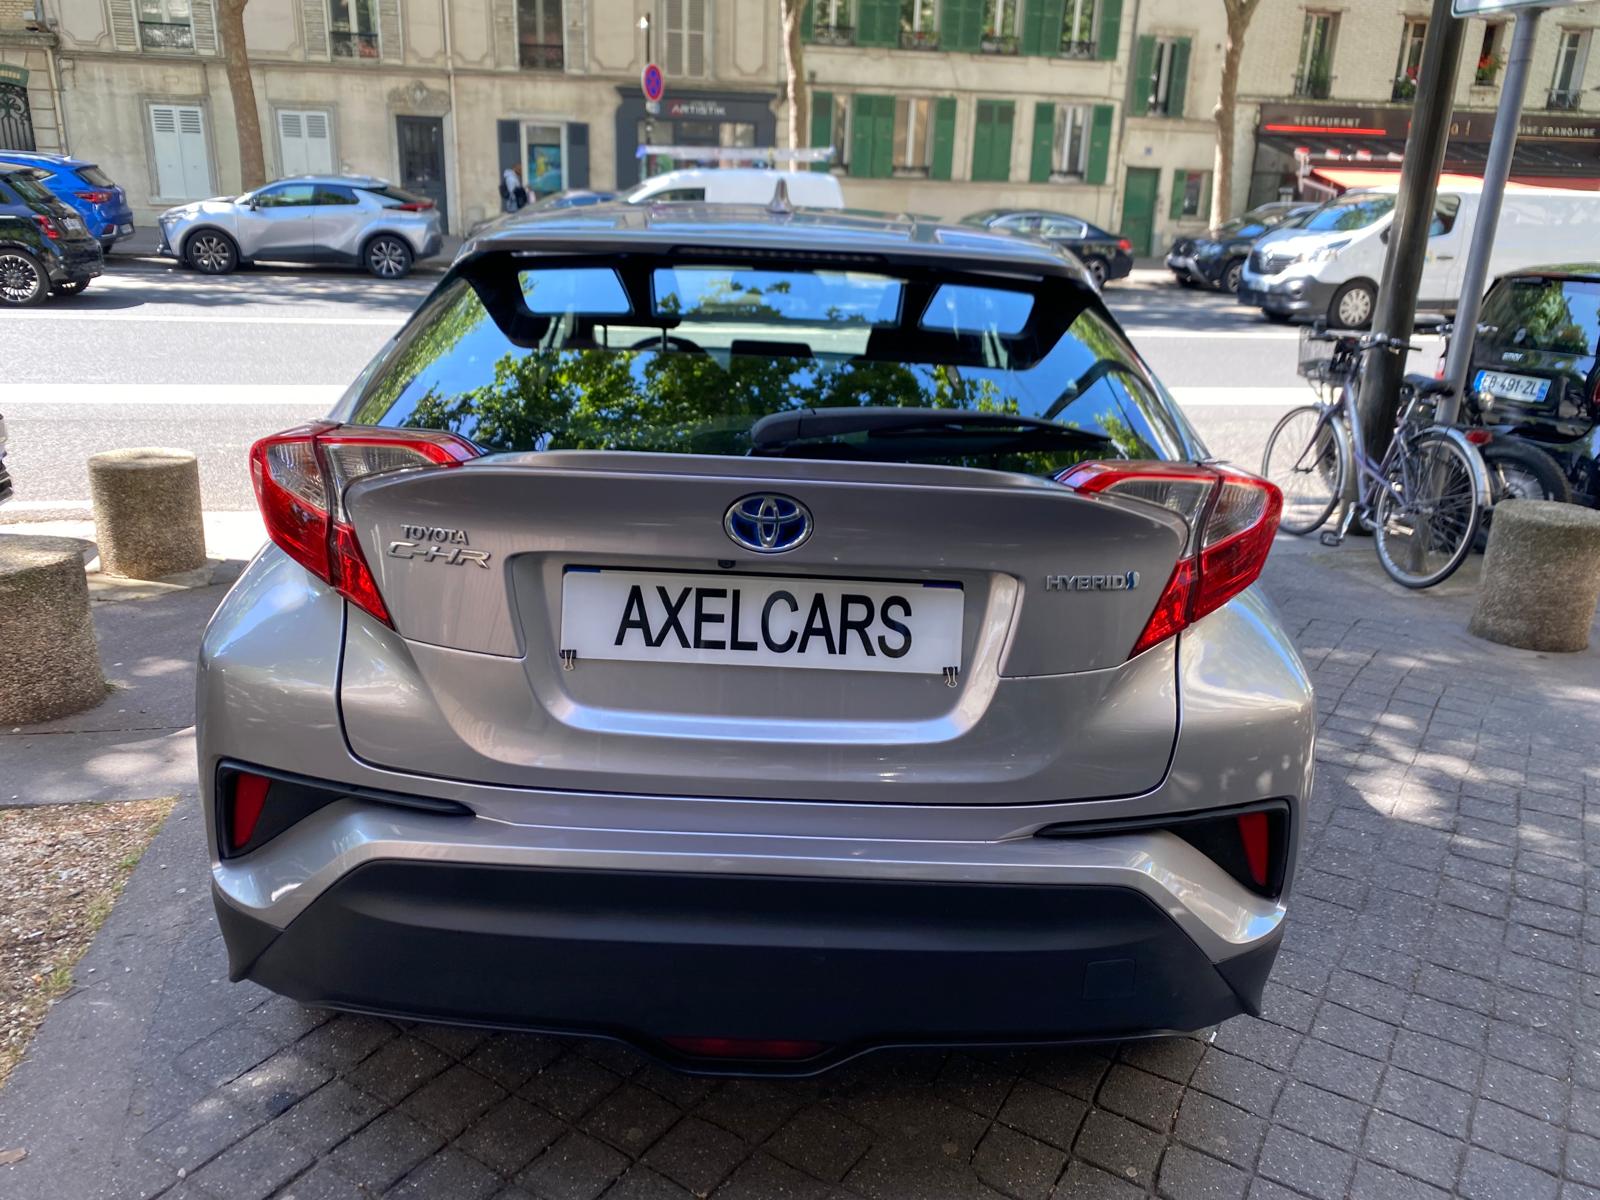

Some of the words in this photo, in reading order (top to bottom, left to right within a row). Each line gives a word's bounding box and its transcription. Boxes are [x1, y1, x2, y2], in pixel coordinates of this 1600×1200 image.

[1294, 115, 1361, 128] RESTAURANT
[400, 524, 470, 546] TOYOTA
[386, 541, 491, 570] C-HR
[1046, 574, 1127, 591] HYBRID
[614, 585, 912, 659] AXELCARS
